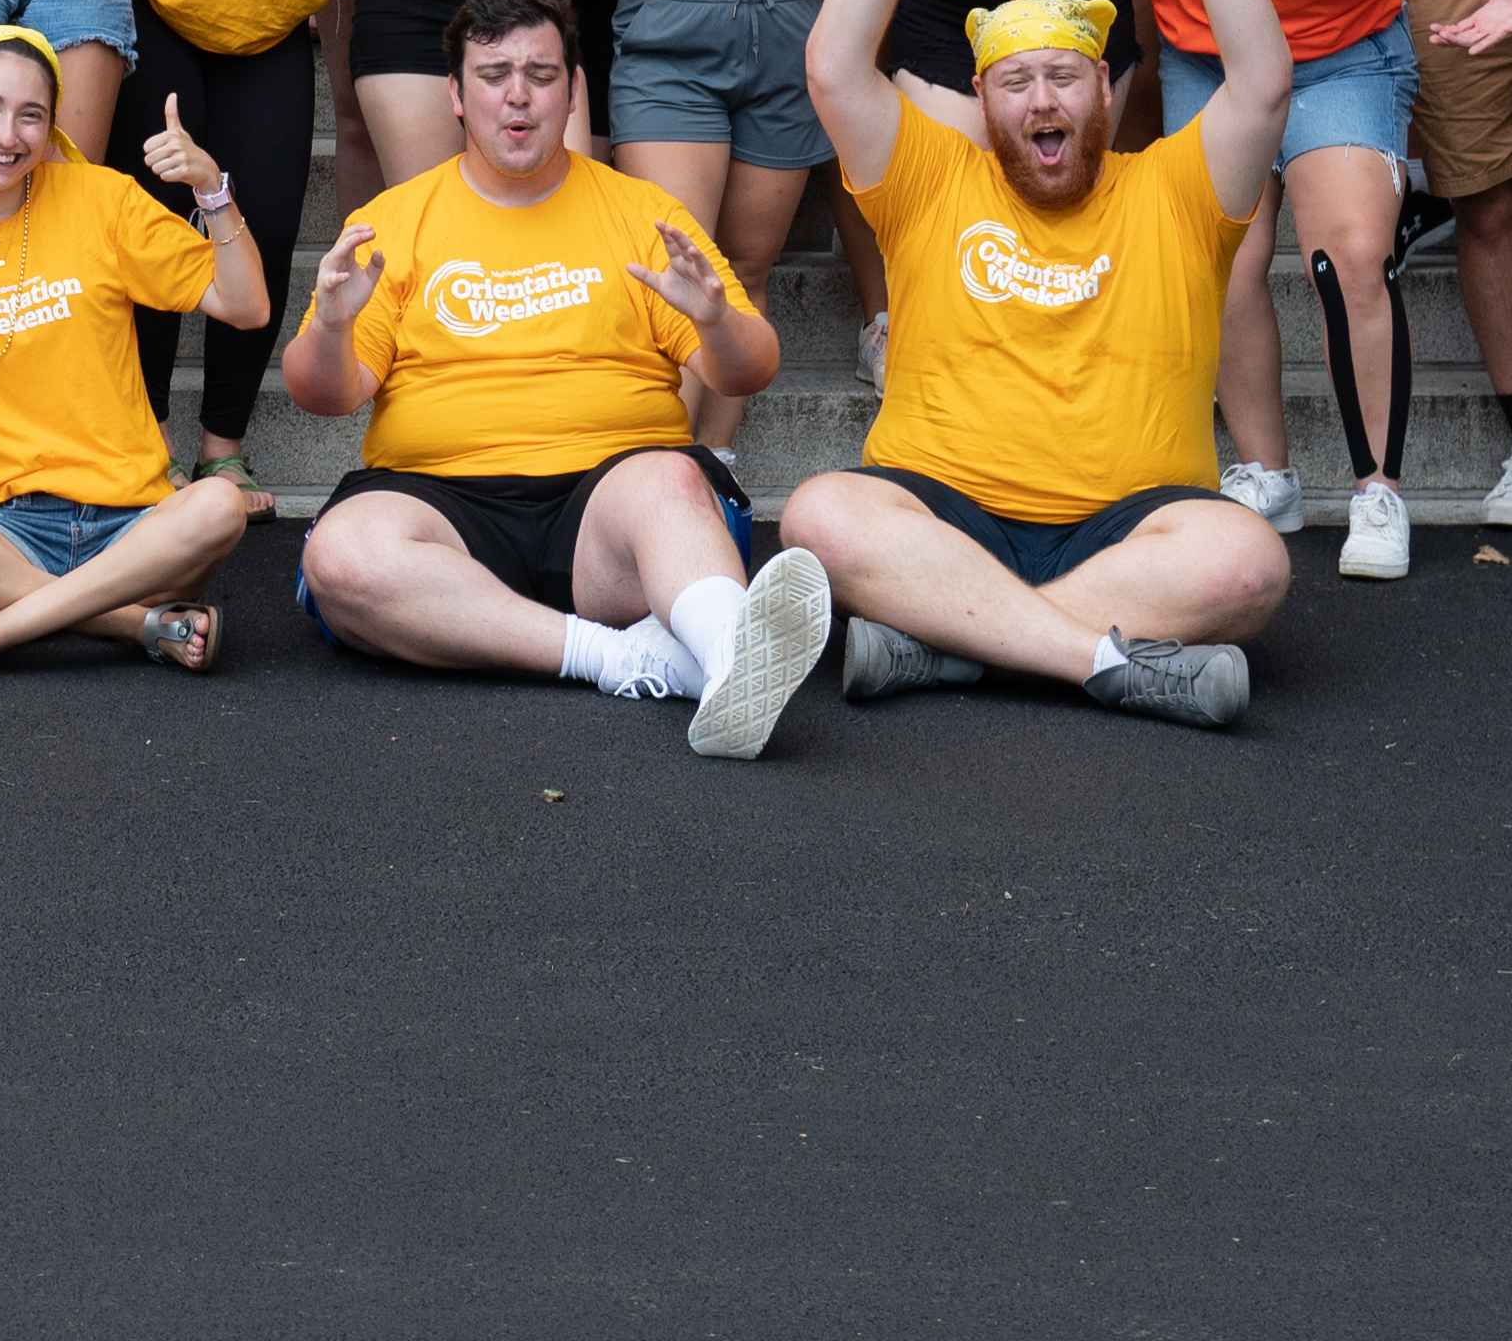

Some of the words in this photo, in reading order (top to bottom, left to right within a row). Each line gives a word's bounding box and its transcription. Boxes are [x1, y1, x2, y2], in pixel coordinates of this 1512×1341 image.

[450, 263, 604, 304] Orientation
[532, 260, 562, 275] College
[986, 253, 1099, 308] Weekend
[1317, 260, 1328, 273] KT
[466, 281, 591, 324] Weekend
